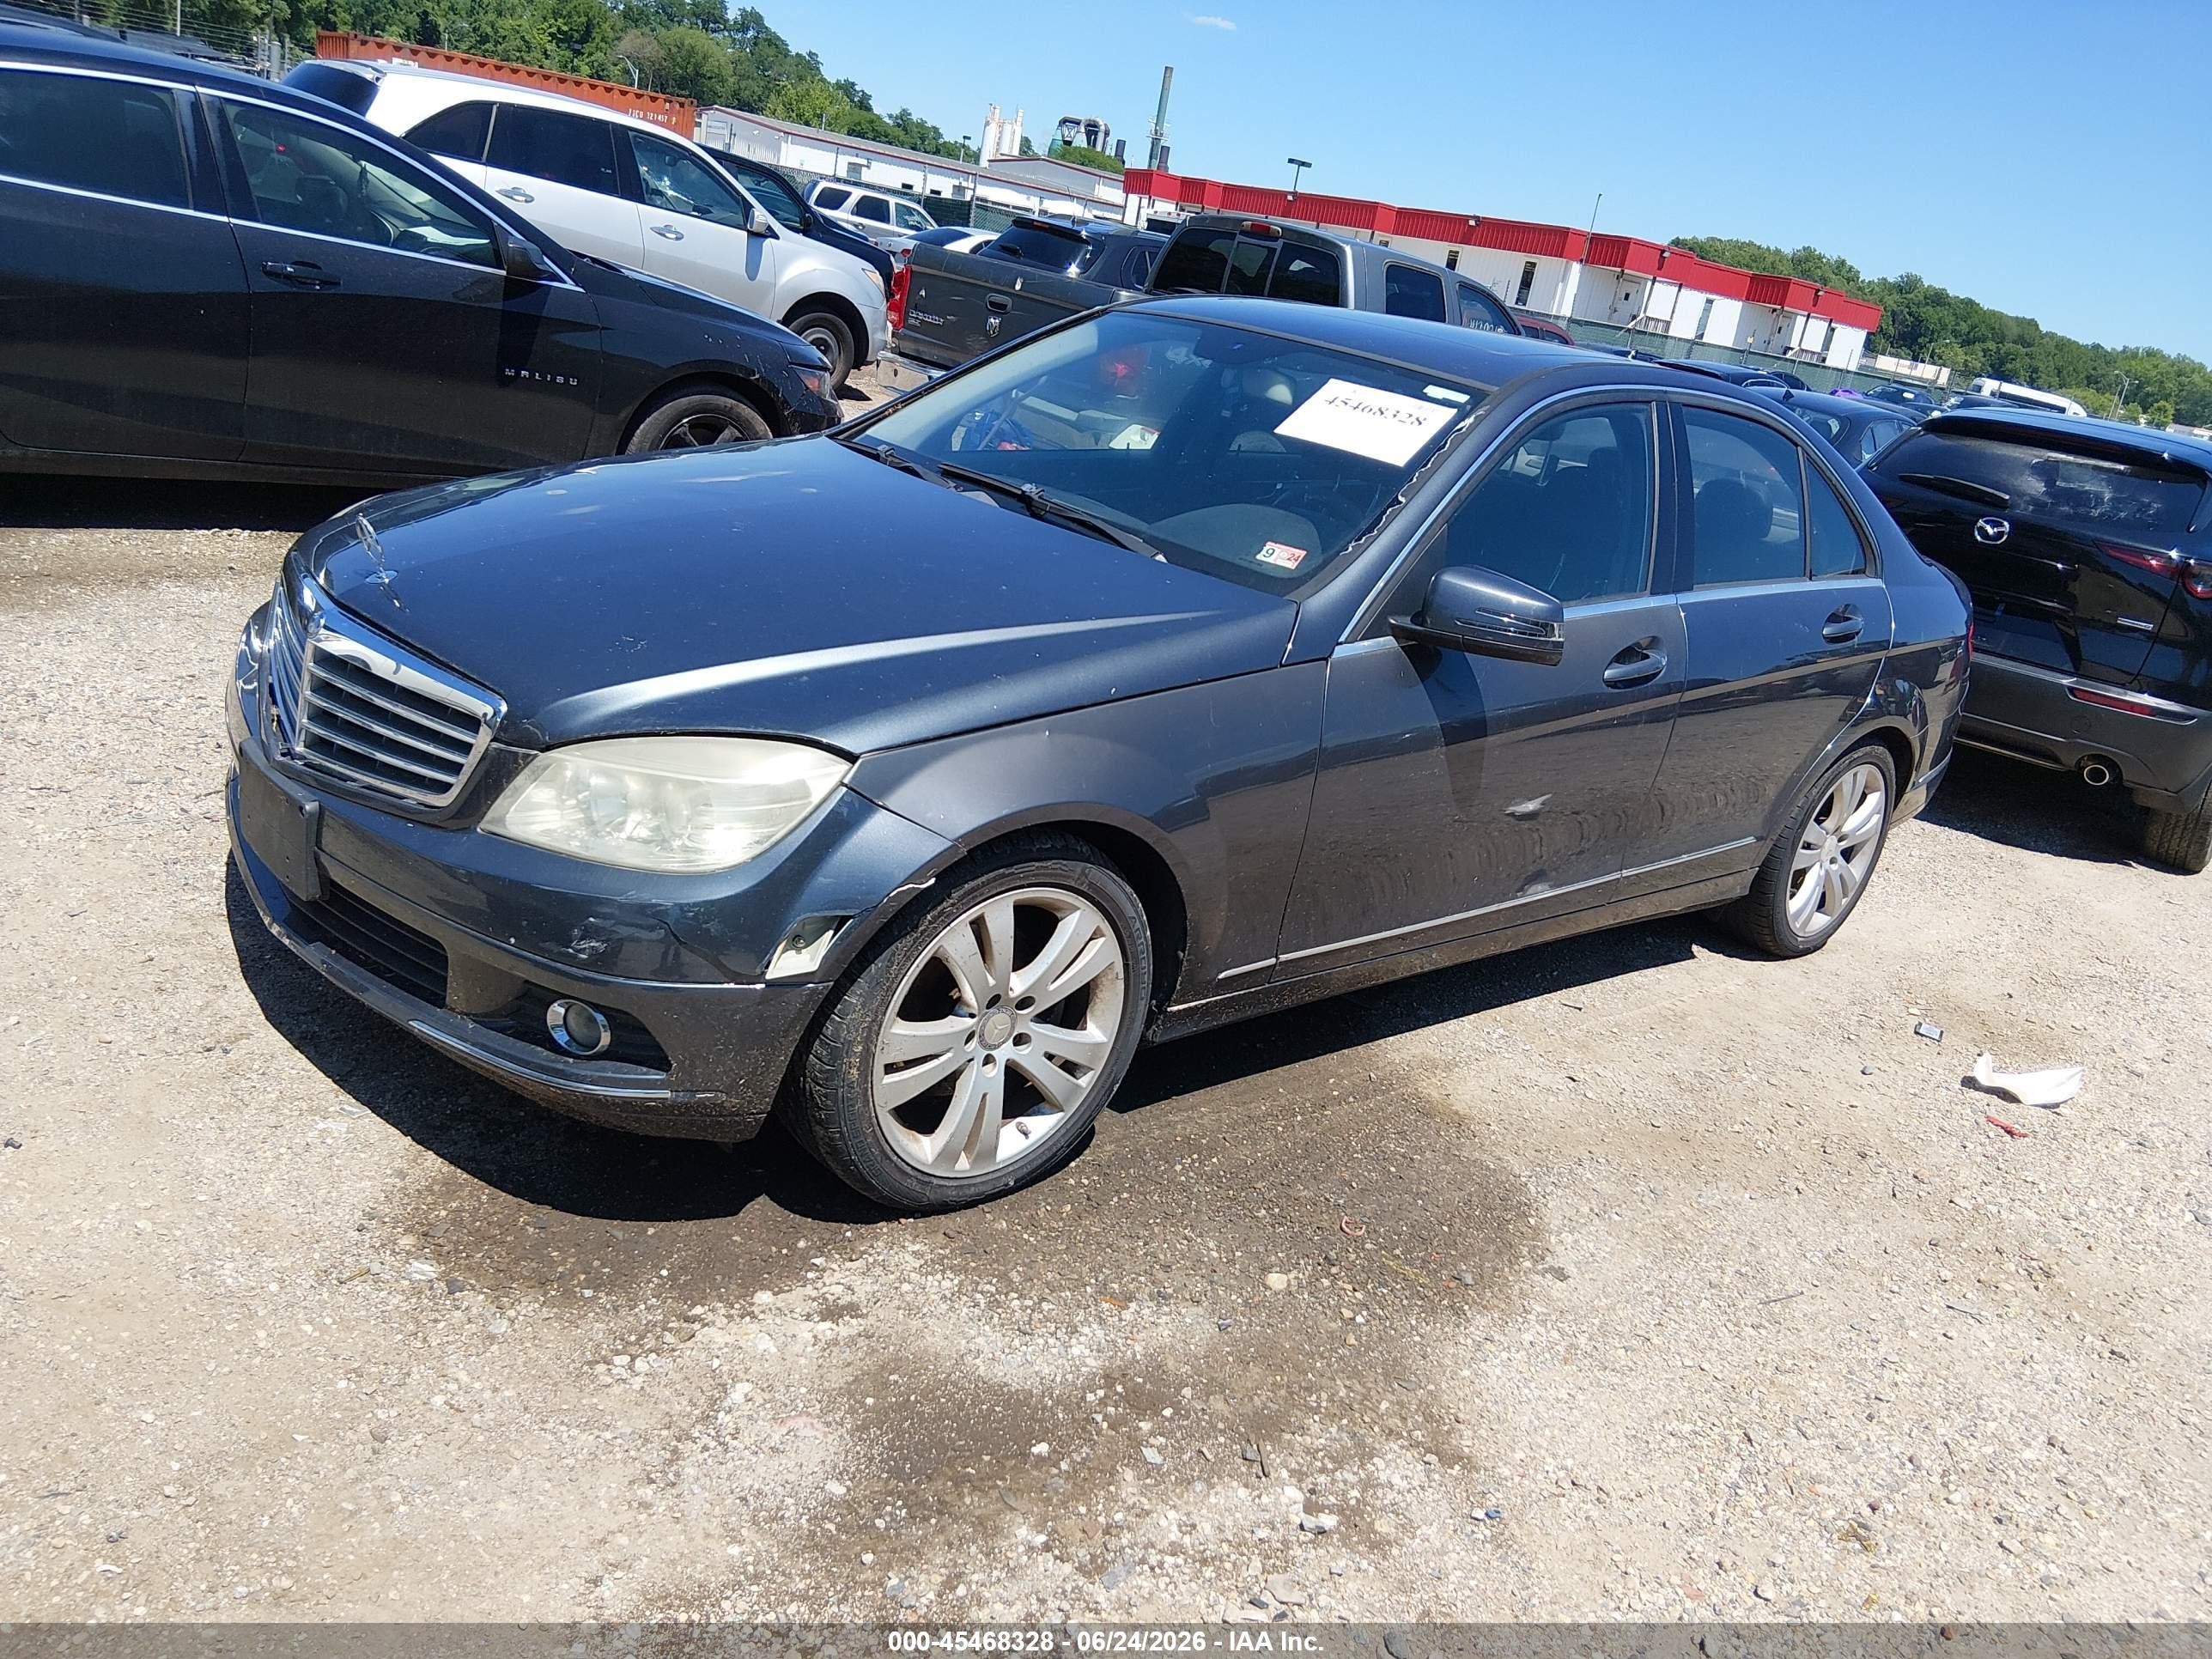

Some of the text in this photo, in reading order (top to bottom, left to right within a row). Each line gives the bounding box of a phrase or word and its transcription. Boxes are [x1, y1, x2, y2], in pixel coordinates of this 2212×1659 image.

[505, 368, 578, 386] MALIBU
[1325, 396, 1427, 427] 45468328
[1263, 548, 1275, 558] 9
